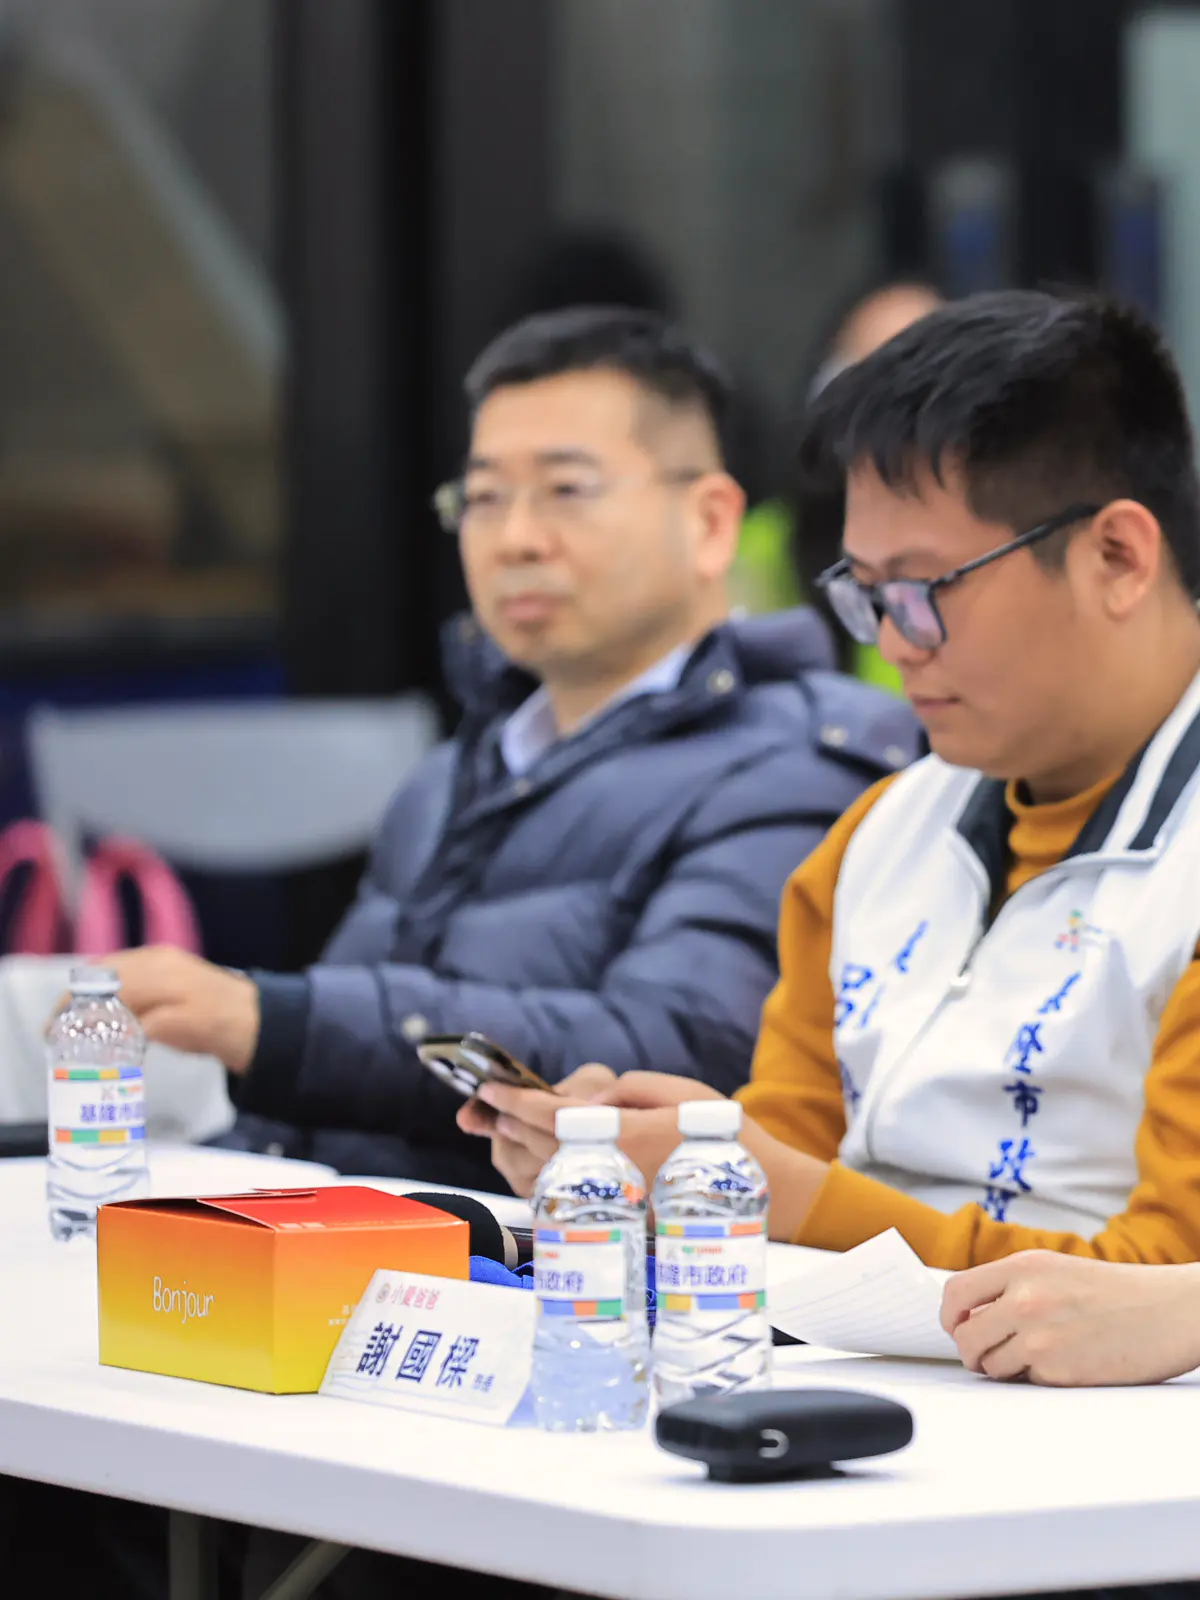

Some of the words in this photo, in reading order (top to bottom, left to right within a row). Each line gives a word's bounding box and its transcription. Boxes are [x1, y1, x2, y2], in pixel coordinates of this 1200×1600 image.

[153, 1275, 215, 1325] Bonjour
[356, 1321, 480, 1388] 謝國樑
